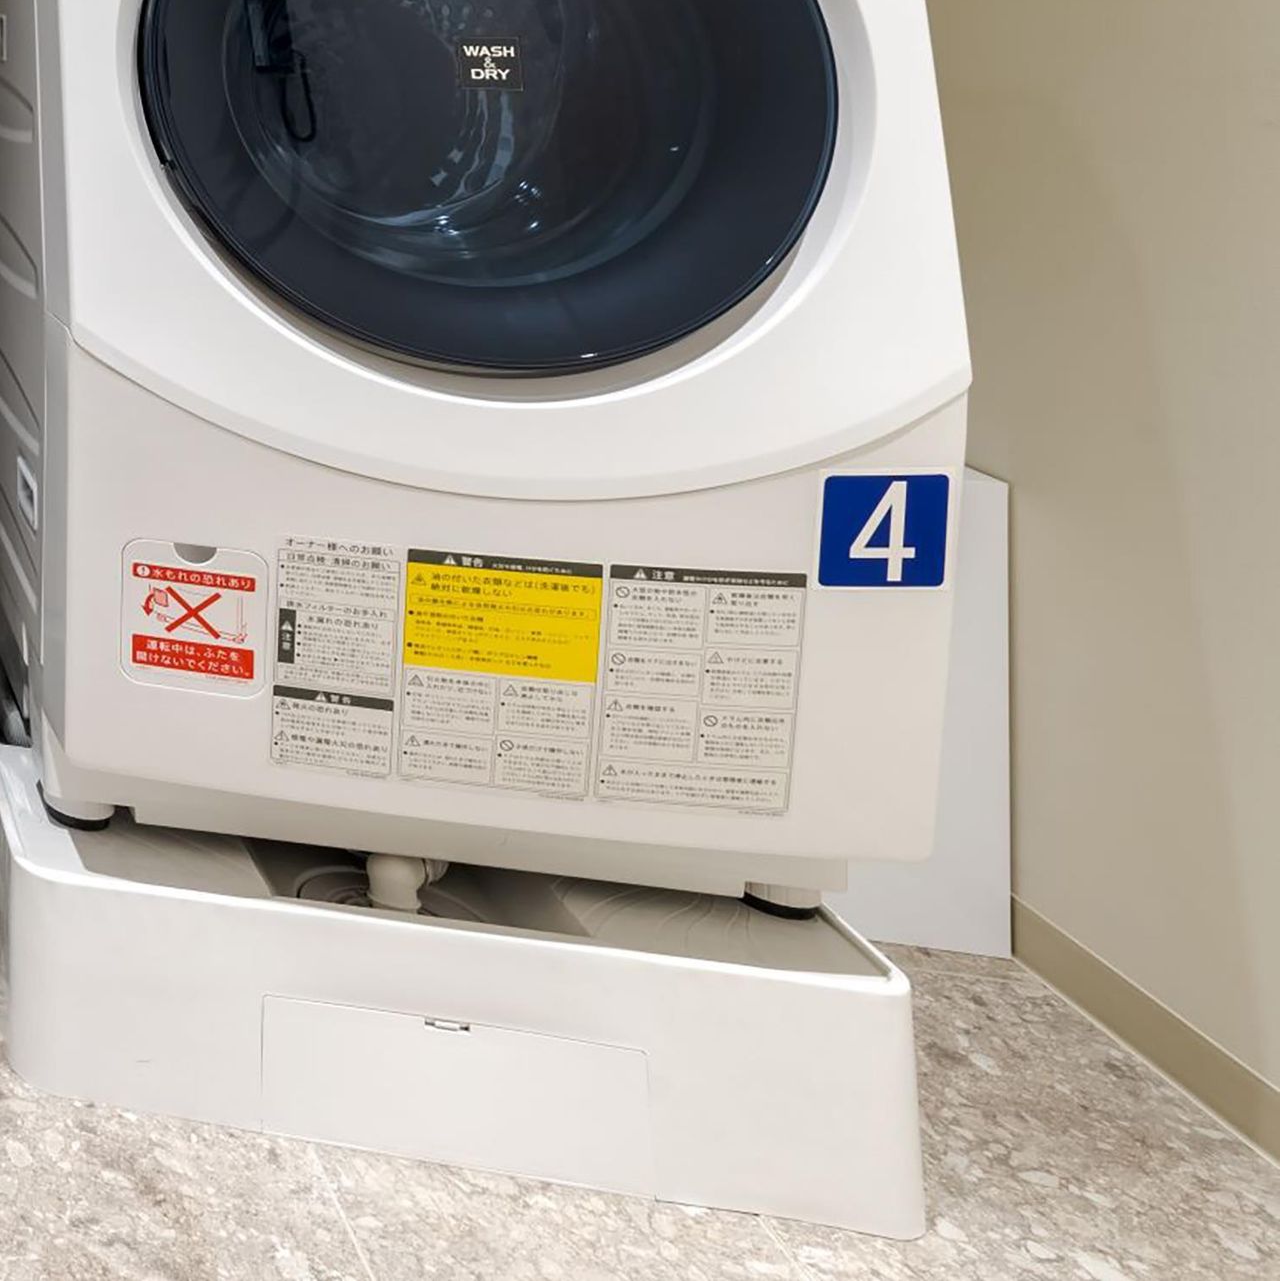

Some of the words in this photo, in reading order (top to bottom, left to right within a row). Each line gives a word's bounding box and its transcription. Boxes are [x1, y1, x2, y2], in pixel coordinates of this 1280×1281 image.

[462, 45, 516, 58] WASH
[483, 56, 496, 69] &
[470, 68, 511, 80] DRY
[848, 481, 916, 582] 4
[286, 538, 394, 556] オーナー様へのお願い
[461, 556, 484, 568] 警告
[152, 568, 252, 590] 水もれの恐れあり
[145, 638, 242, 663] 運転中は、ふたを
[136, 650, 252, 678] 開けないでください。
